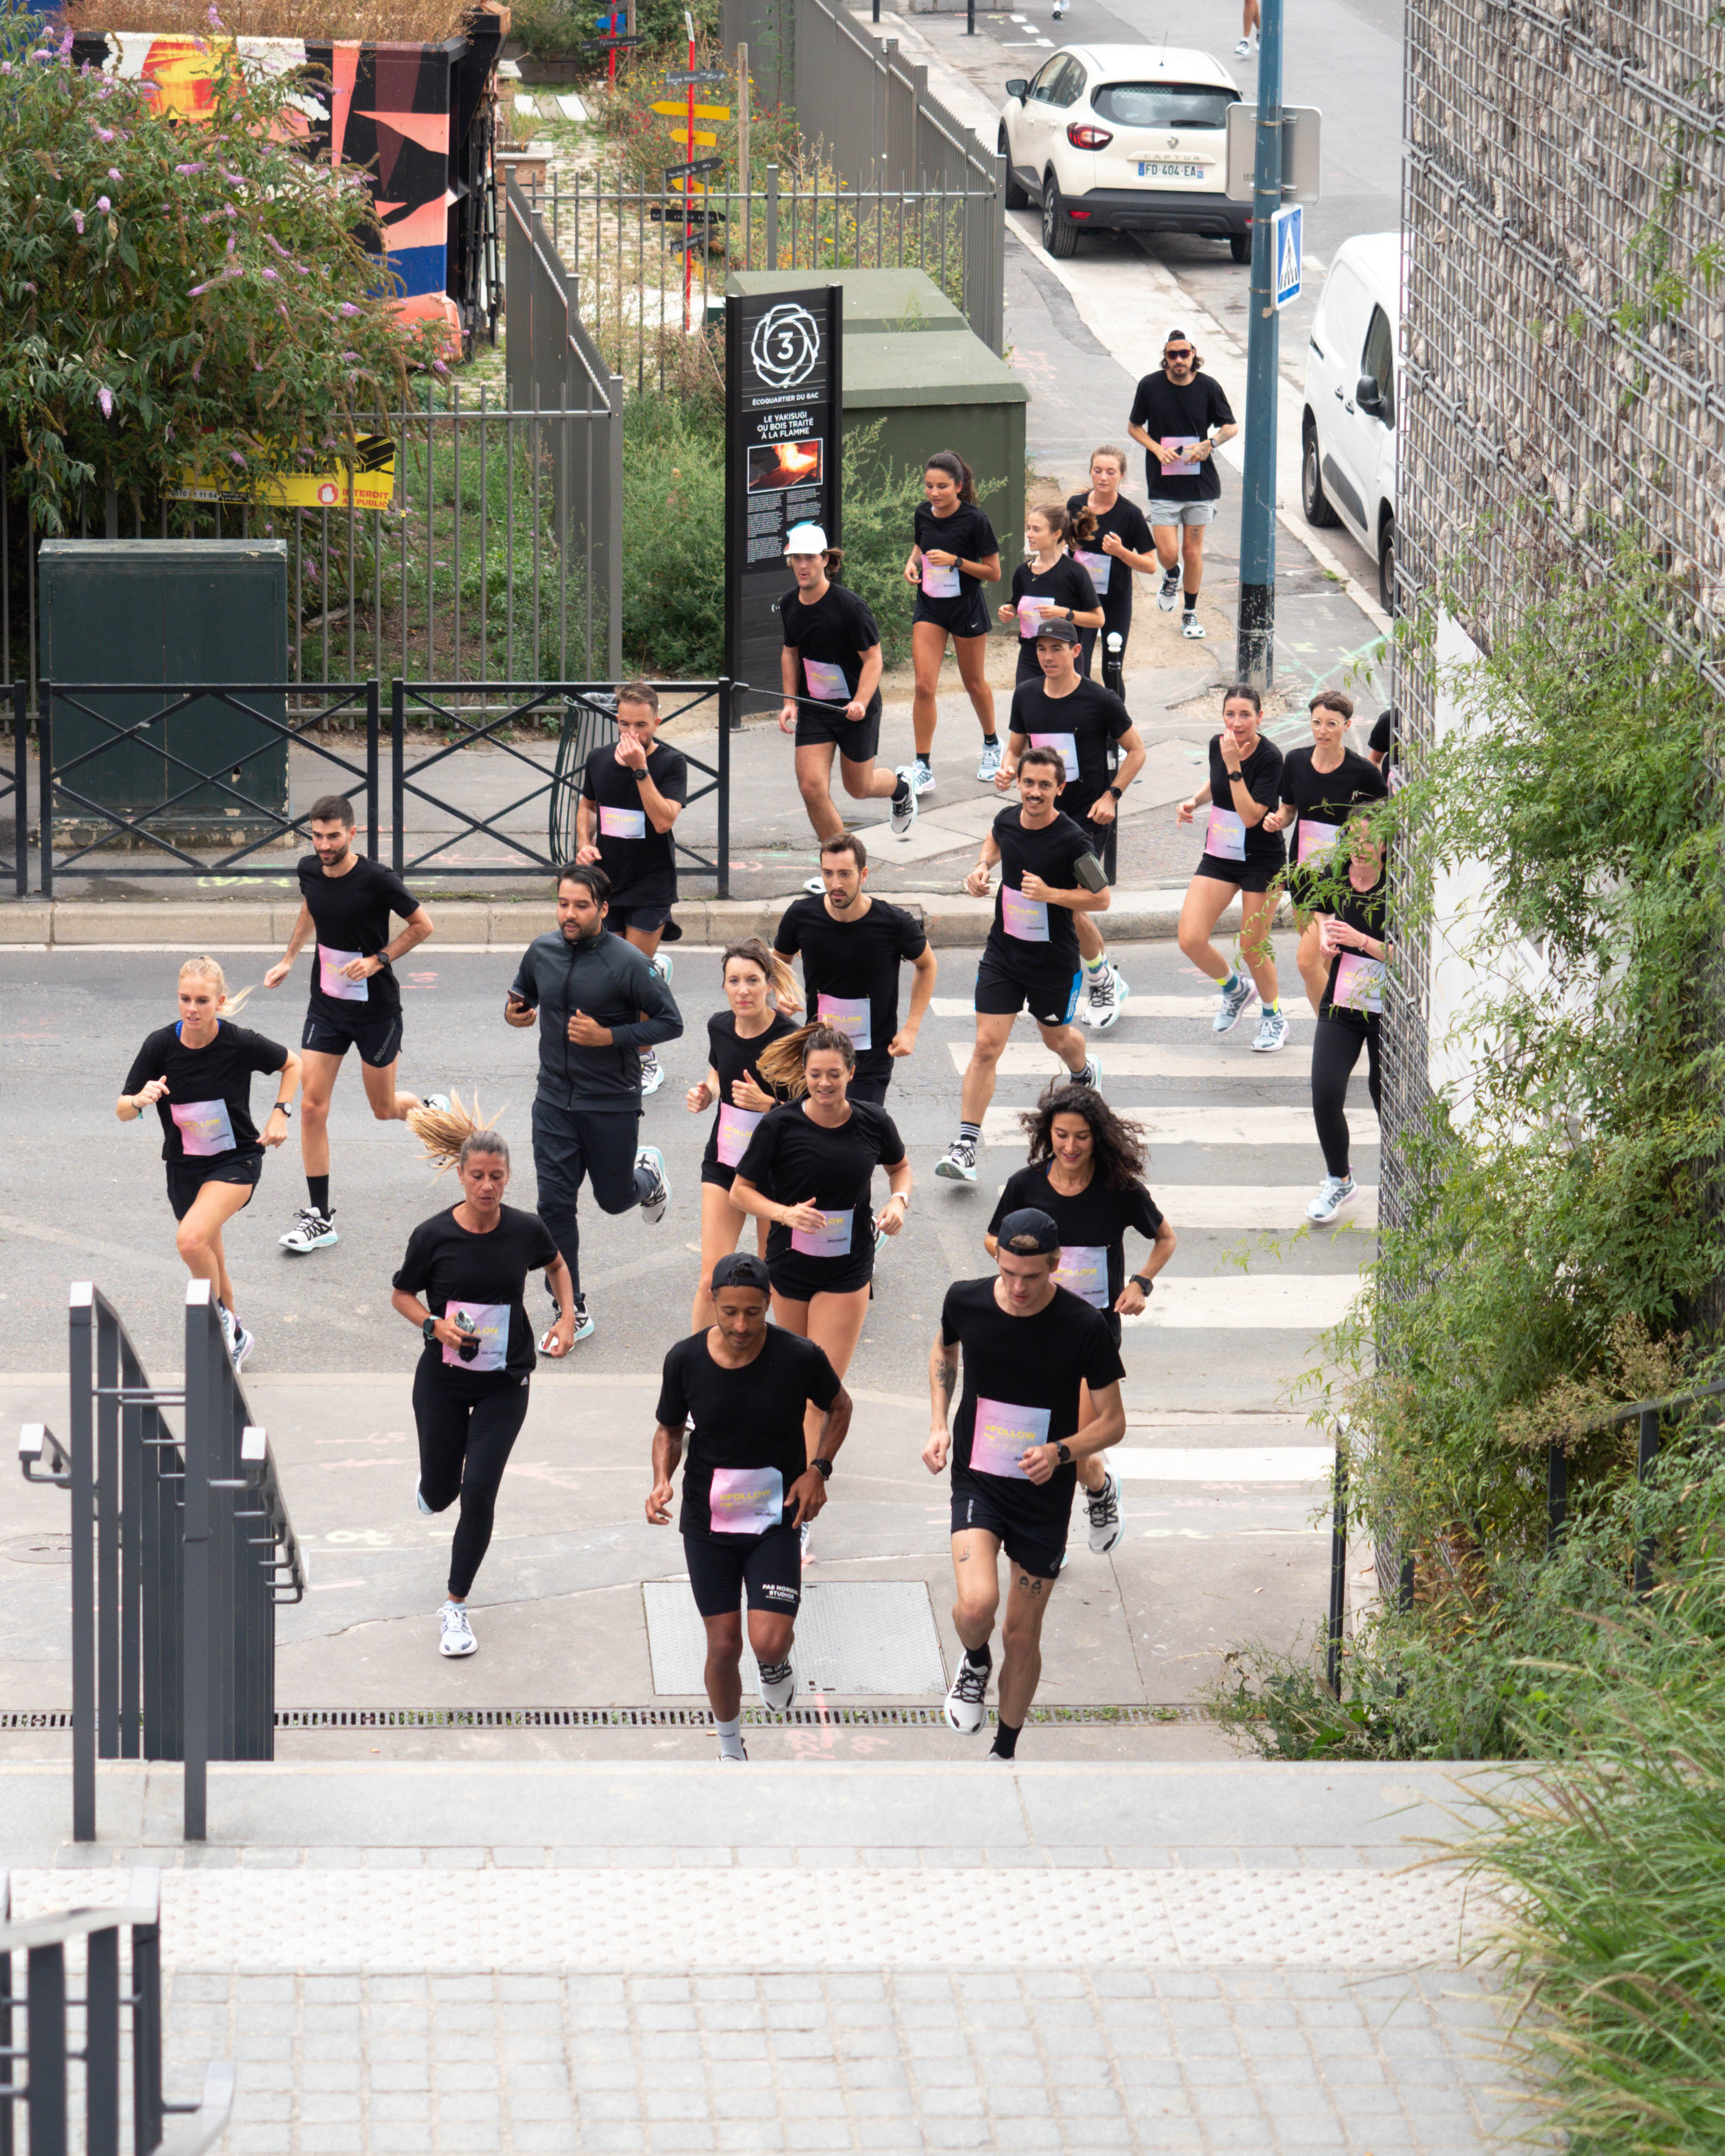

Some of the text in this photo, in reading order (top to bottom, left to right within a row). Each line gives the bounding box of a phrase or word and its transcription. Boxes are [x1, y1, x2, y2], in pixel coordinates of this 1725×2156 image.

[777, 331, 793, 360] 3
[752, 395, 795, 406] ÉCOQUARTIER
[774, 411, 807, 422] YAKISUGI
[770, 421, 787, 430] BOIS
[789, 417, 814, 428] TRAITÉ
[761, 431, 767, 439] À
[780, 427, 810, 437] FLAMME
[356, 498, 388, 508] PUBLIC
[769, 1590, 794, 1600] STUDIOS
